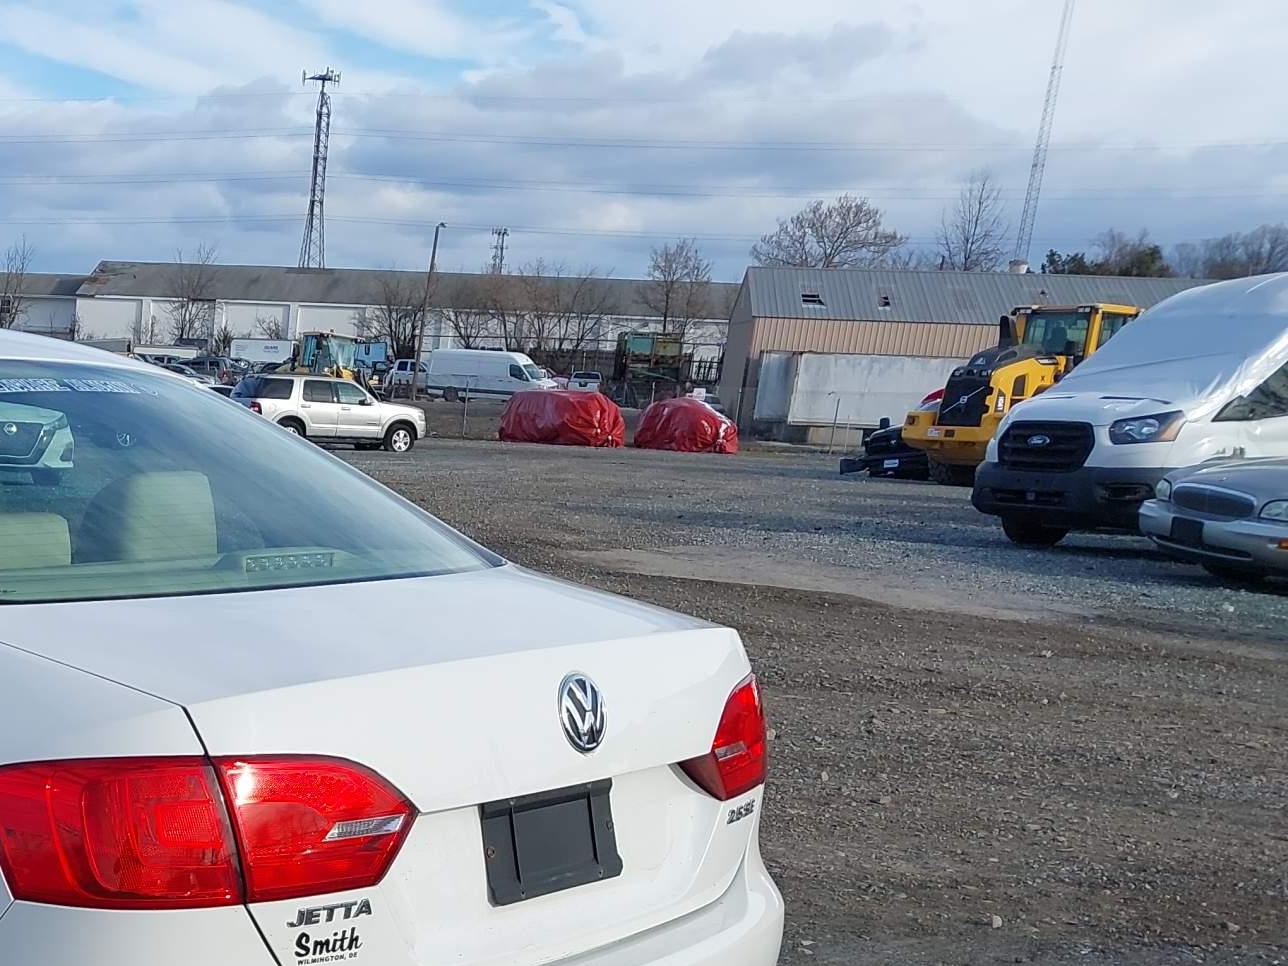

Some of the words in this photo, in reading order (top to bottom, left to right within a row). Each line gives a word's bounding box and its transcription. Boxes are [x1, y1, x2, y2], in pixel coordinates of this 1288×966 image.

[286, 898, 372, 928] JETTA
[294, 926, 363, 958] Smith
[297, 953, 347, 966] WILMINGTON,
[348, 951, 358, 959] DE
